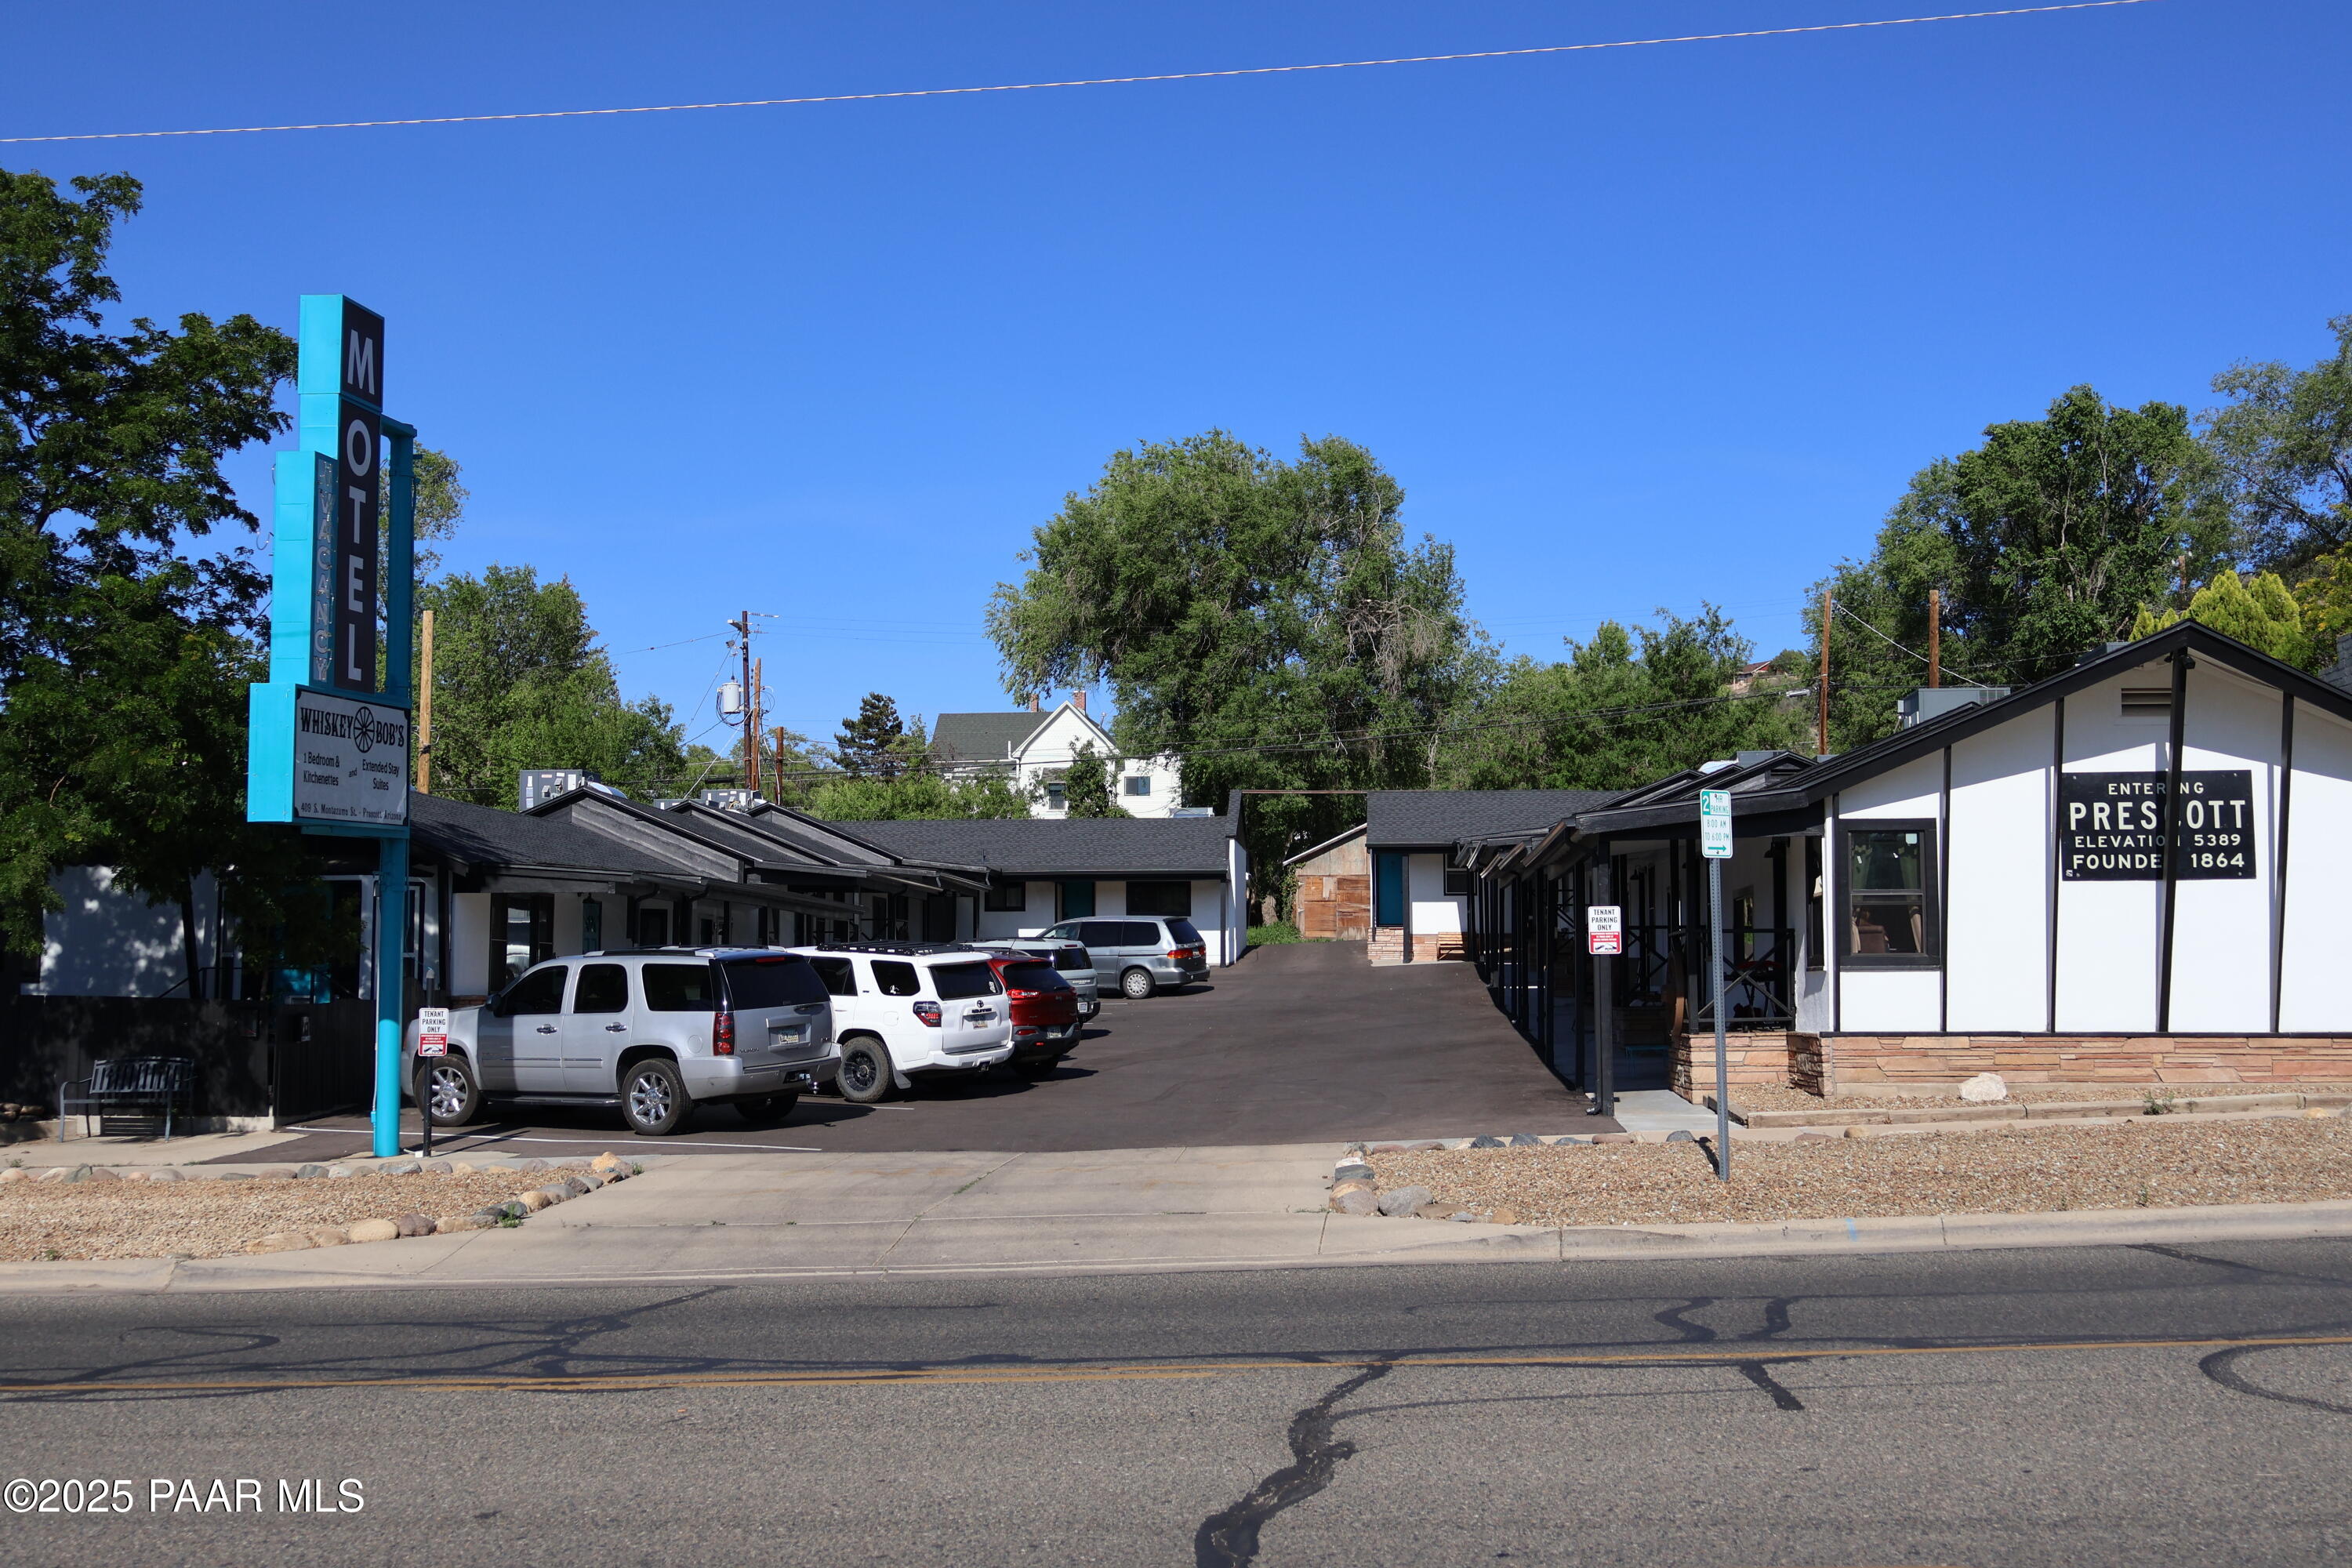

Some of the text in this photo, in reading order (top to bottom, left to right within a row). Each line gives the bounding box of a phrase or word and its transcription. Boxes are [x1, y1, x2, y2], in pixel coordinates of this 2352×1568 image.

[347, 328, 376, 681] MOTEL
[314, 492, 332, 681] VACANCY
[300, 707, 404, 747] WHISKEY BOB'S
[303, 751, 340, 768] 1 Bedroom &
[348, 768, 358, 778] and
[362, 759, 400, 777] Extended Stay
[303, 770, 339, 786] Kitchenettes
[372, 777, 389, 791] Suites
[2108, 782, 2205, 795] ENTERNG
[1702, 795, 1710, 811] 2
[1715, 795, 1723, 804] HR
[301, 802, 311, 813] 409
[1711, 804, 1729, 814] PARKING
[2069, 800, 2246, 830] PRESOTT
[1720, 820, 1726, 829] AM
[1704, 832, 1730, 841] TO 6:00 PM
[2194, 833, 2241, 846] 5389
[2073, 853, 2245, 869] FOUNDE 1864
